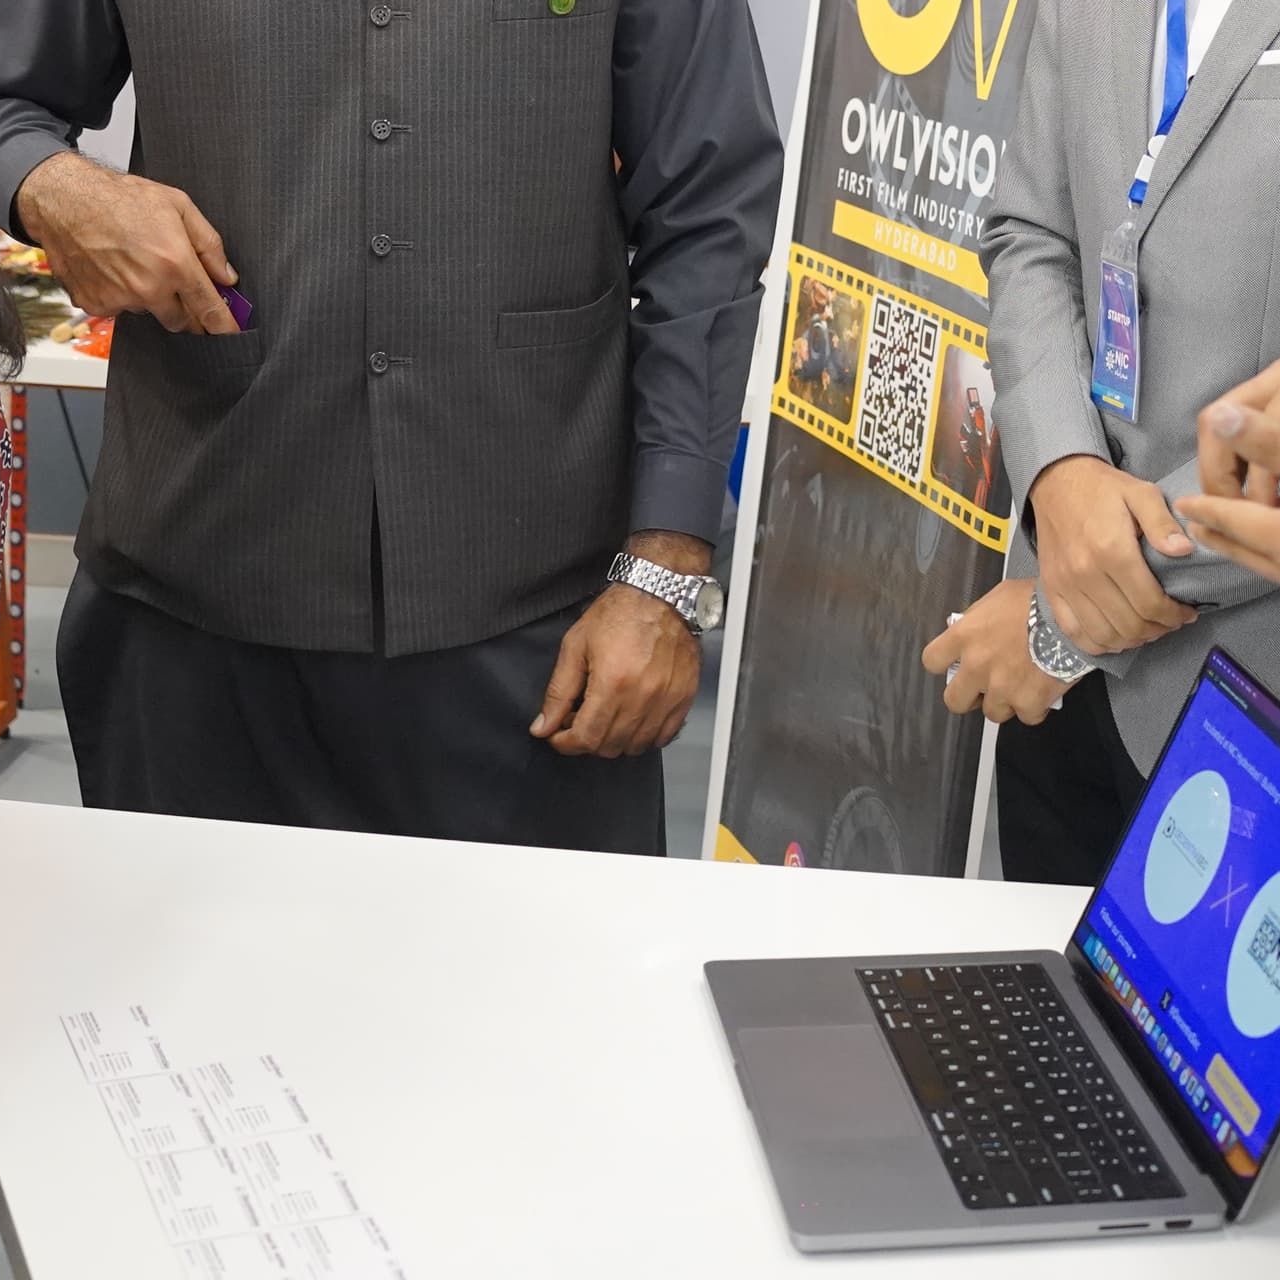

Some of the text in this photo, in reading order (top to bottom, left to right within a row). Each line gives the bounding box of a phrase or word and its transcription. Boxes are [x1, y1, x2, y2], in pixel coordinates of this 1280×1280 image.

[841, 97, 1006, 199] OWLVISIO
[837, 168, 985, 240] FIRST FILM INDUSTRY
[873, 220, 958, 272] HYDERABAD
[1107, 309, 1131, 328] STARTUP
[1115, 350, 1129, 369] NIC
